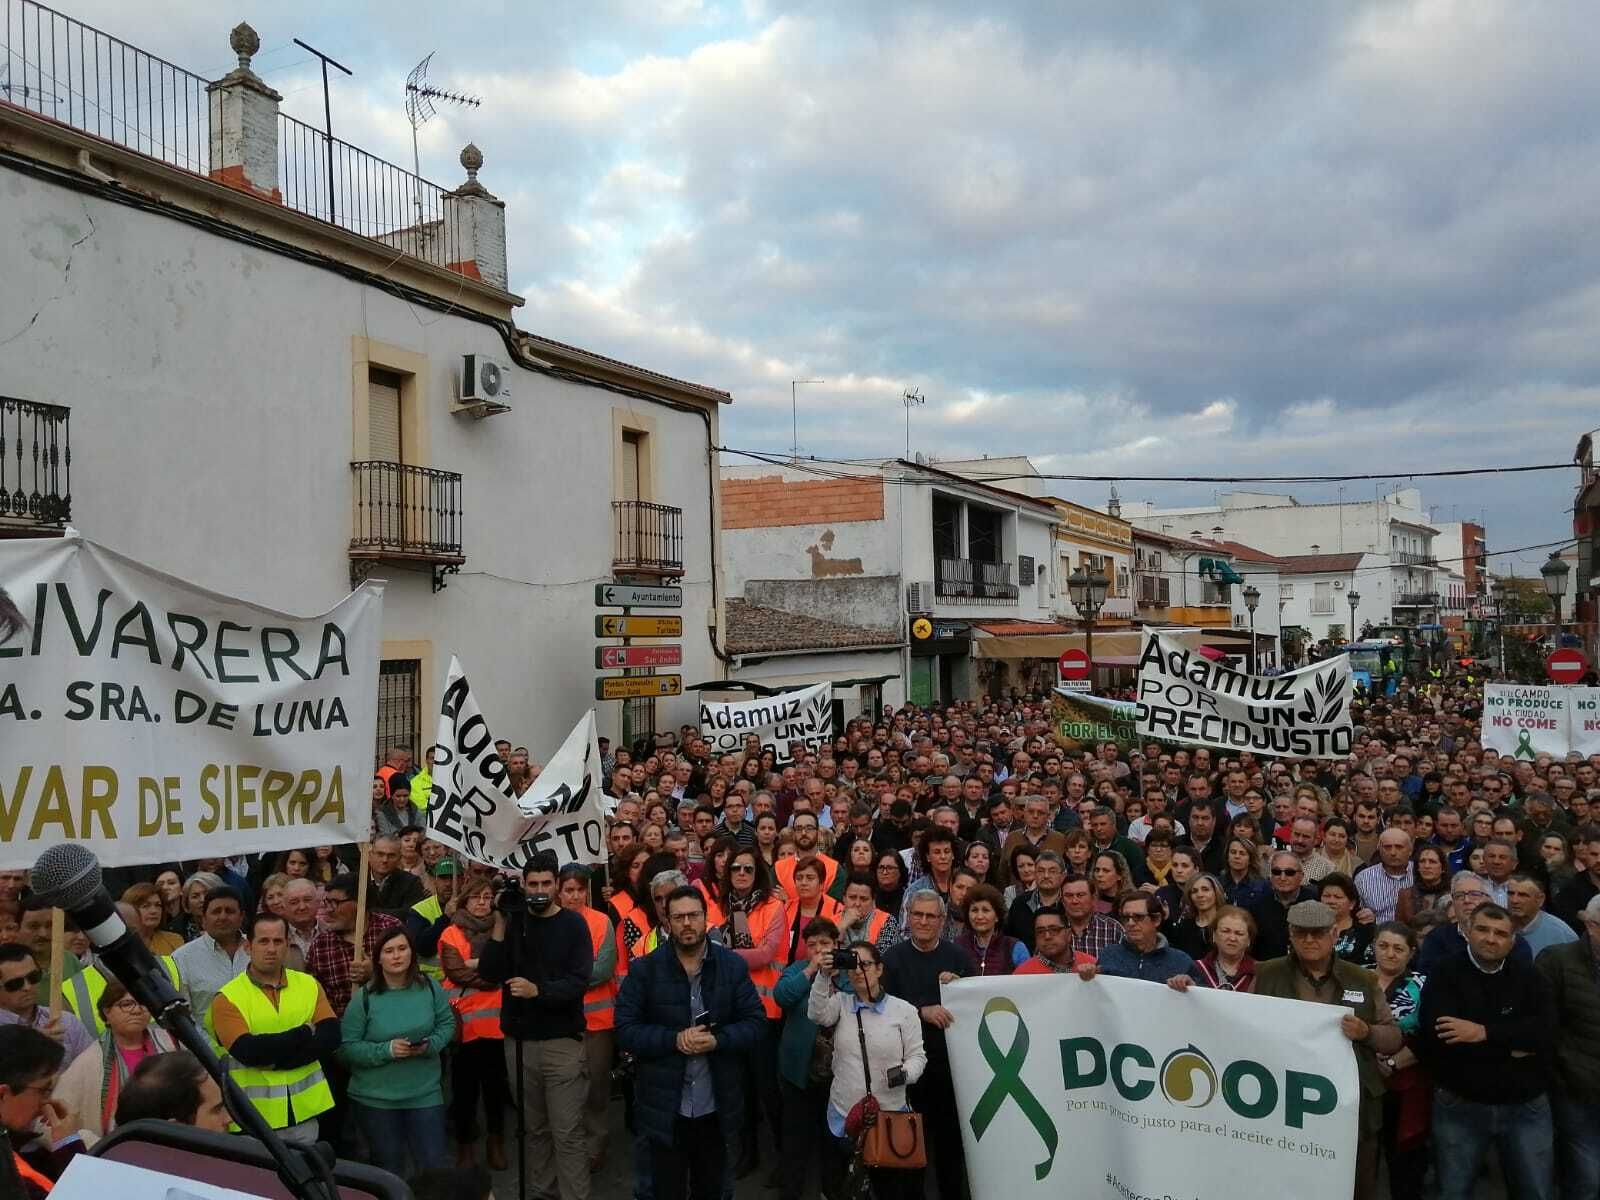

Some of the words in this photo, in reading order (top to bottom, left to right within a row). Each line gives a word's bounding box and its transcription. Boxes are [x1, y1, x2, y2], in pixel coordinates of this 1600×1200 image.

[632, 591, 680, 602] Ayuntamiento
[1138, 633, 1298, 701] Adamuz
[1140, 679, 1220, 715] POR
[1488, 697, 1505, 706] NO
[1508, 698, 1563, 709] PRODUCE
[1514, 689, 1550, 699] CAMPO
[64, 680, 161, 724] SRA.
[174, 689, 239, 730] DE
[252, 696, 349, 737] LUNA
[700, 699, 801, 730] Adamuz
[1515, 709, 1546, 719] CIUDAD
[1577, 700, 1596, 710] NO
[1250, 706, 1295, 728] UN
[1492, 716, 1513, 727] NO
[1517, 718, 1557, 729] COME
[774, 722, 806, 740] UN
[1061, 723, 1091, 738] POR
[138, 776, 184, 837] DE
[198, 763, 346, 834] SIERRA
[1059, 1036, 1339, 1130] DCOOP
[1066, 1099, 1089, 1112] Por
[1092, 1100, 1109, 1111] un
[1109, 1105, 1140, 1126] precio
[1141, 1116, 1176, 1130] justo
[1180, 1120, 1212, 1133] para
[1215, 1124, 1228, 1137] el
[1231, 1129, 1274, 1147] aceite
[1278, 1135, 1296, 1152] de
[1299, 1142, 1337, 1161] oliva
